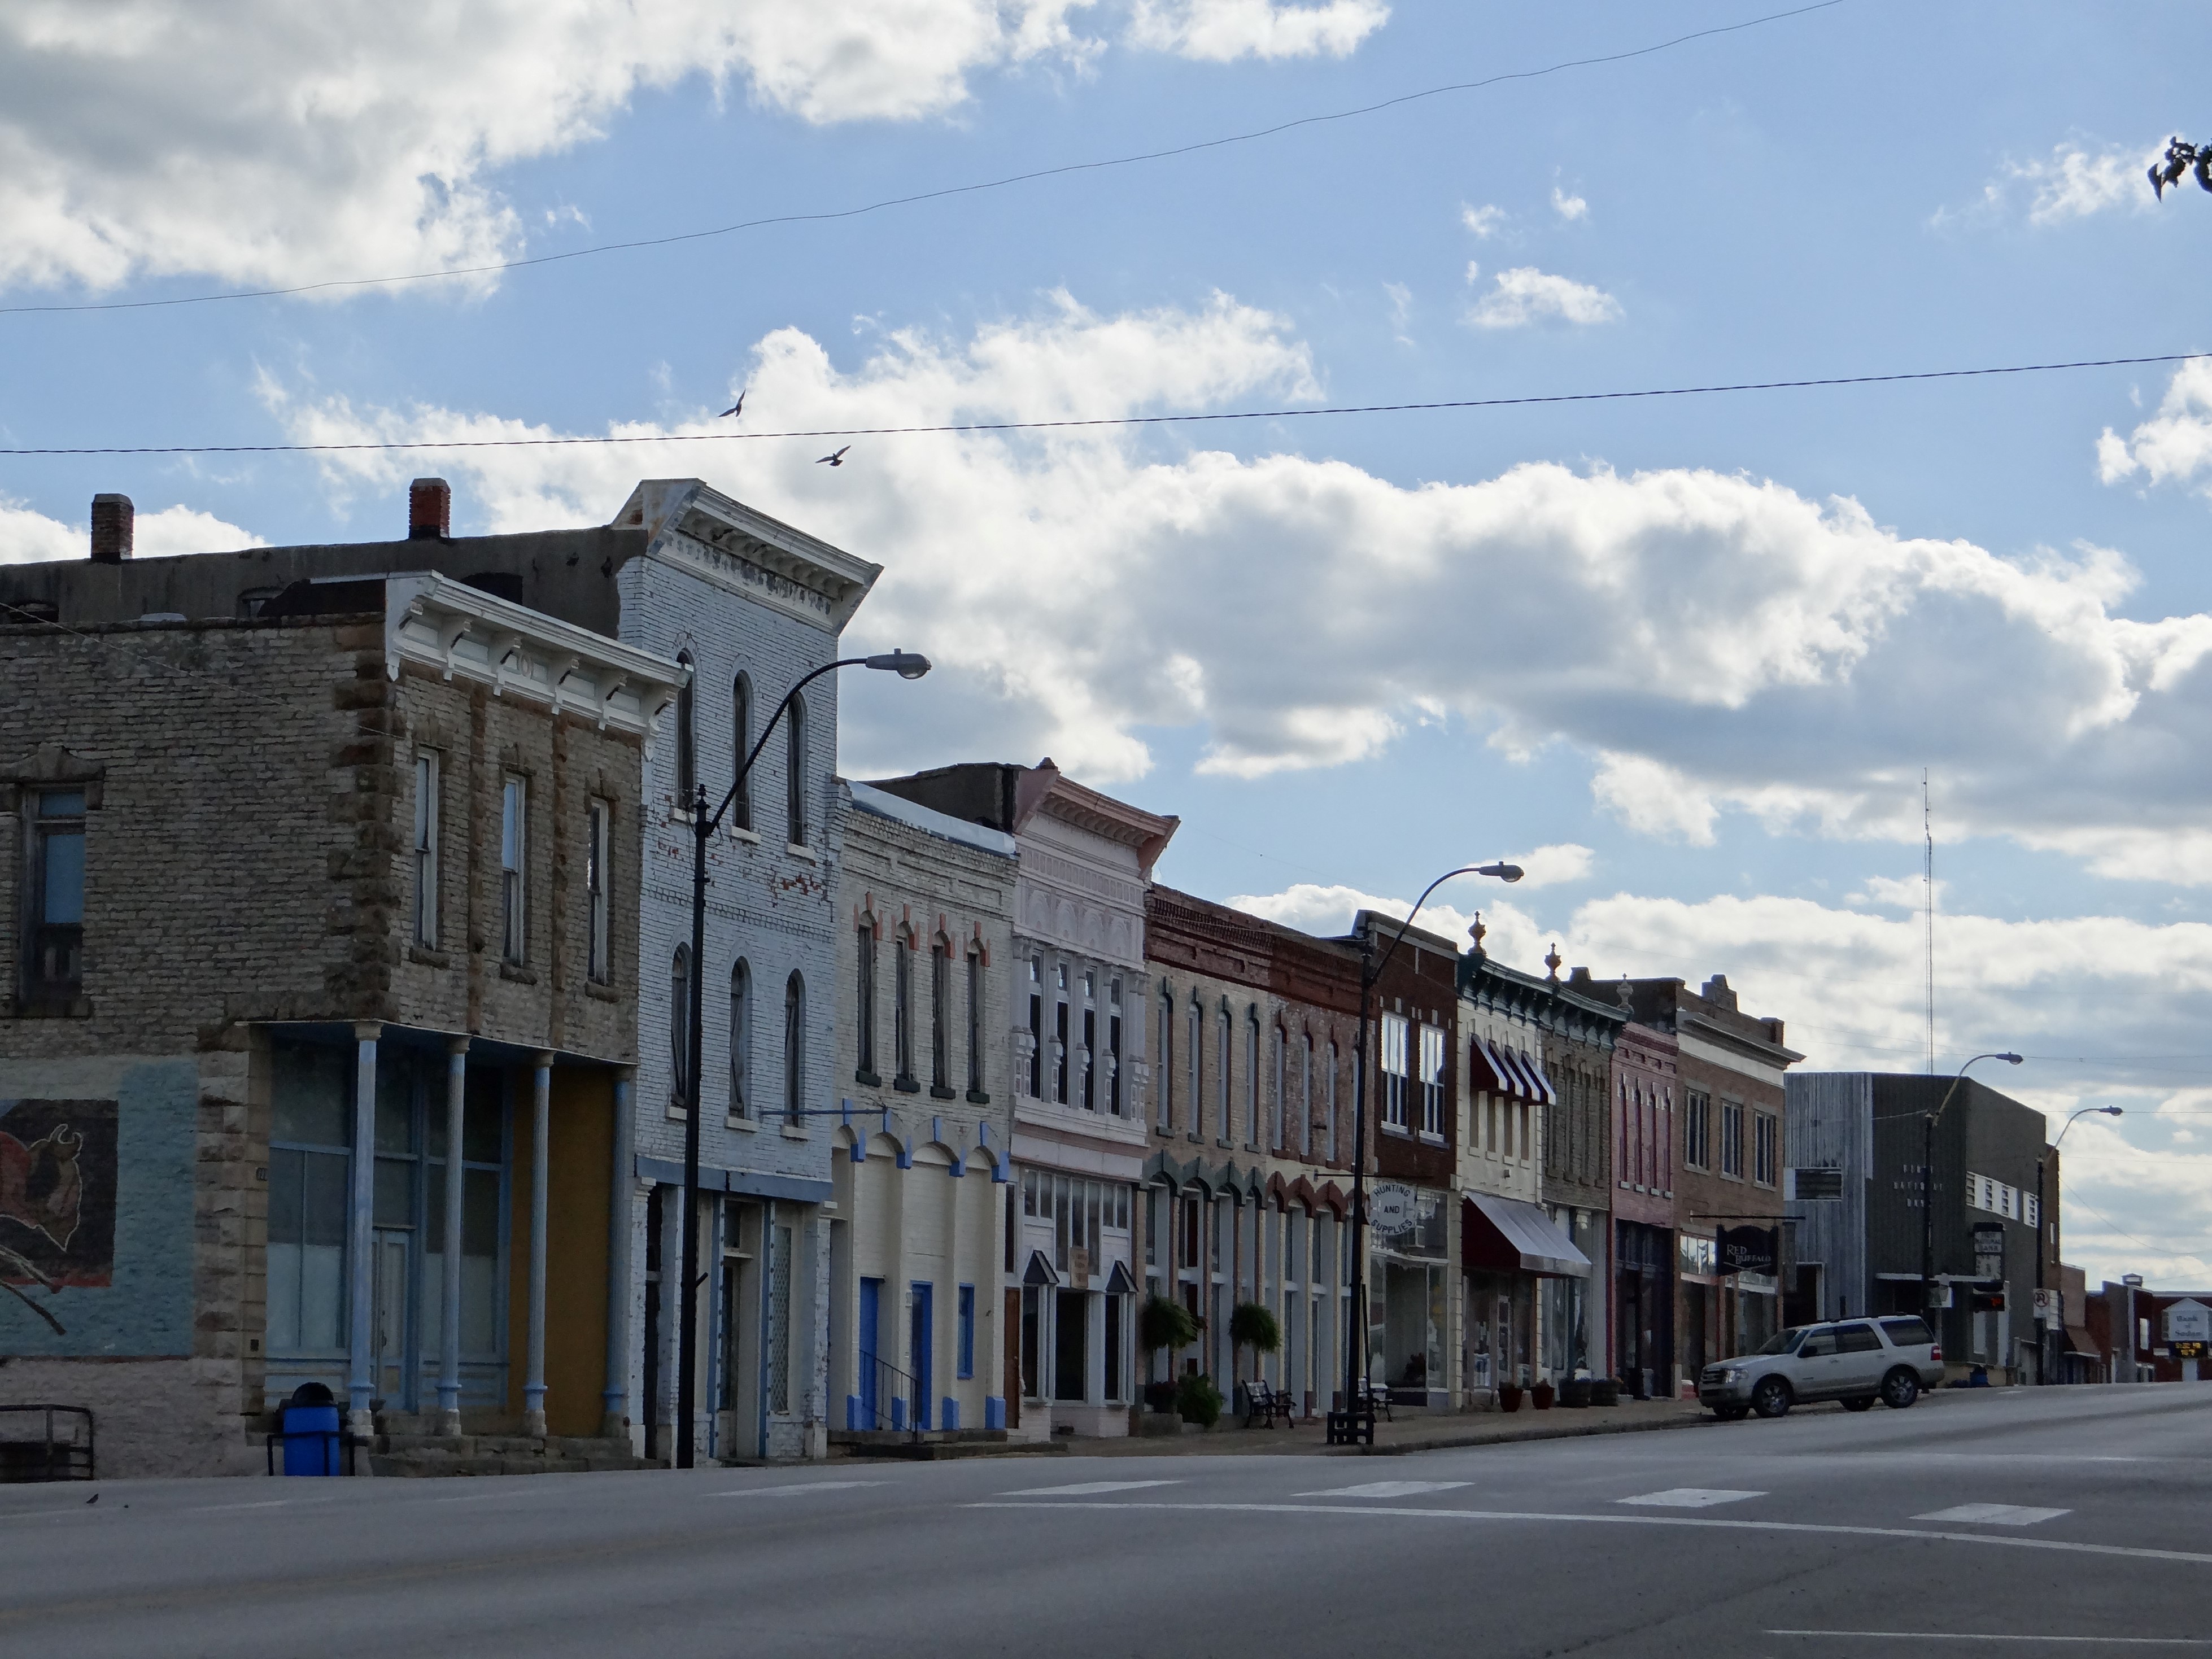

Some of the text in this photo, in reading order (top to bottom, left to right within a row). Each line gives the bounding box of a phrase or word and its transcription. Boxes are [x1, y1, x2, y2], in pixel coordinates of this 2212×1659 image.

[1373, 1184, 1411, 1197] HUNTING
[1384, 1205, 1401, 1214] AND
[1371, 1219, 1412, 1234] SUPPLIES
[1726, 1244, 1748, 1256] RED
[1735, 1255, 1772, 1264] BUFFALO
